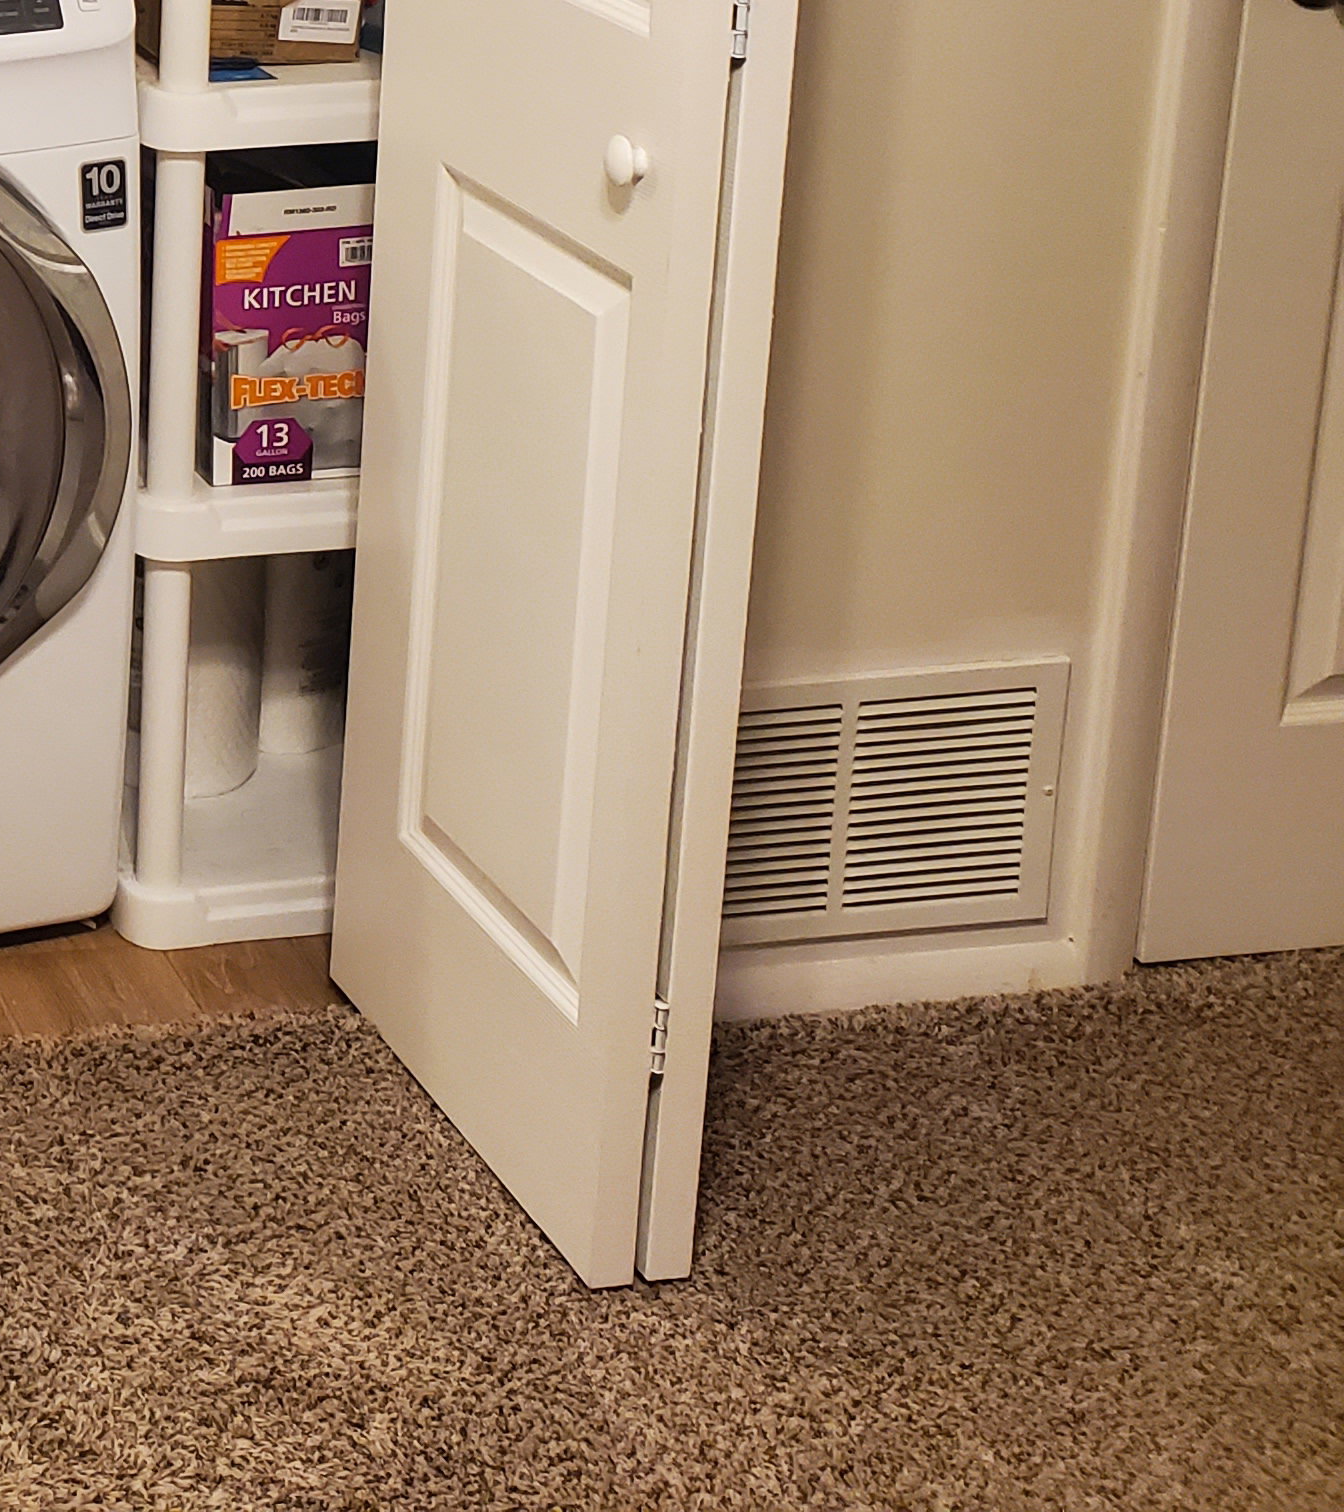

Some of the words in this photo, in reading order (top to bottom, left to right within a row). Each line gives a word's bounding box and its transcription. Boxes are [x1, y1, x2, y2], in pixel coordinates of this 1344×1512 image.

[85, 163, 121, 196] 10
[243, 279, 356, 310] KITCHEN
[333, 311, 366, 325] Bags
[256, 423, 289, 448] 13
[255, 448, 288, 457] GALLON
[242, 466, 265, 479] 200
[268, 463, 304, 477] BAGS
